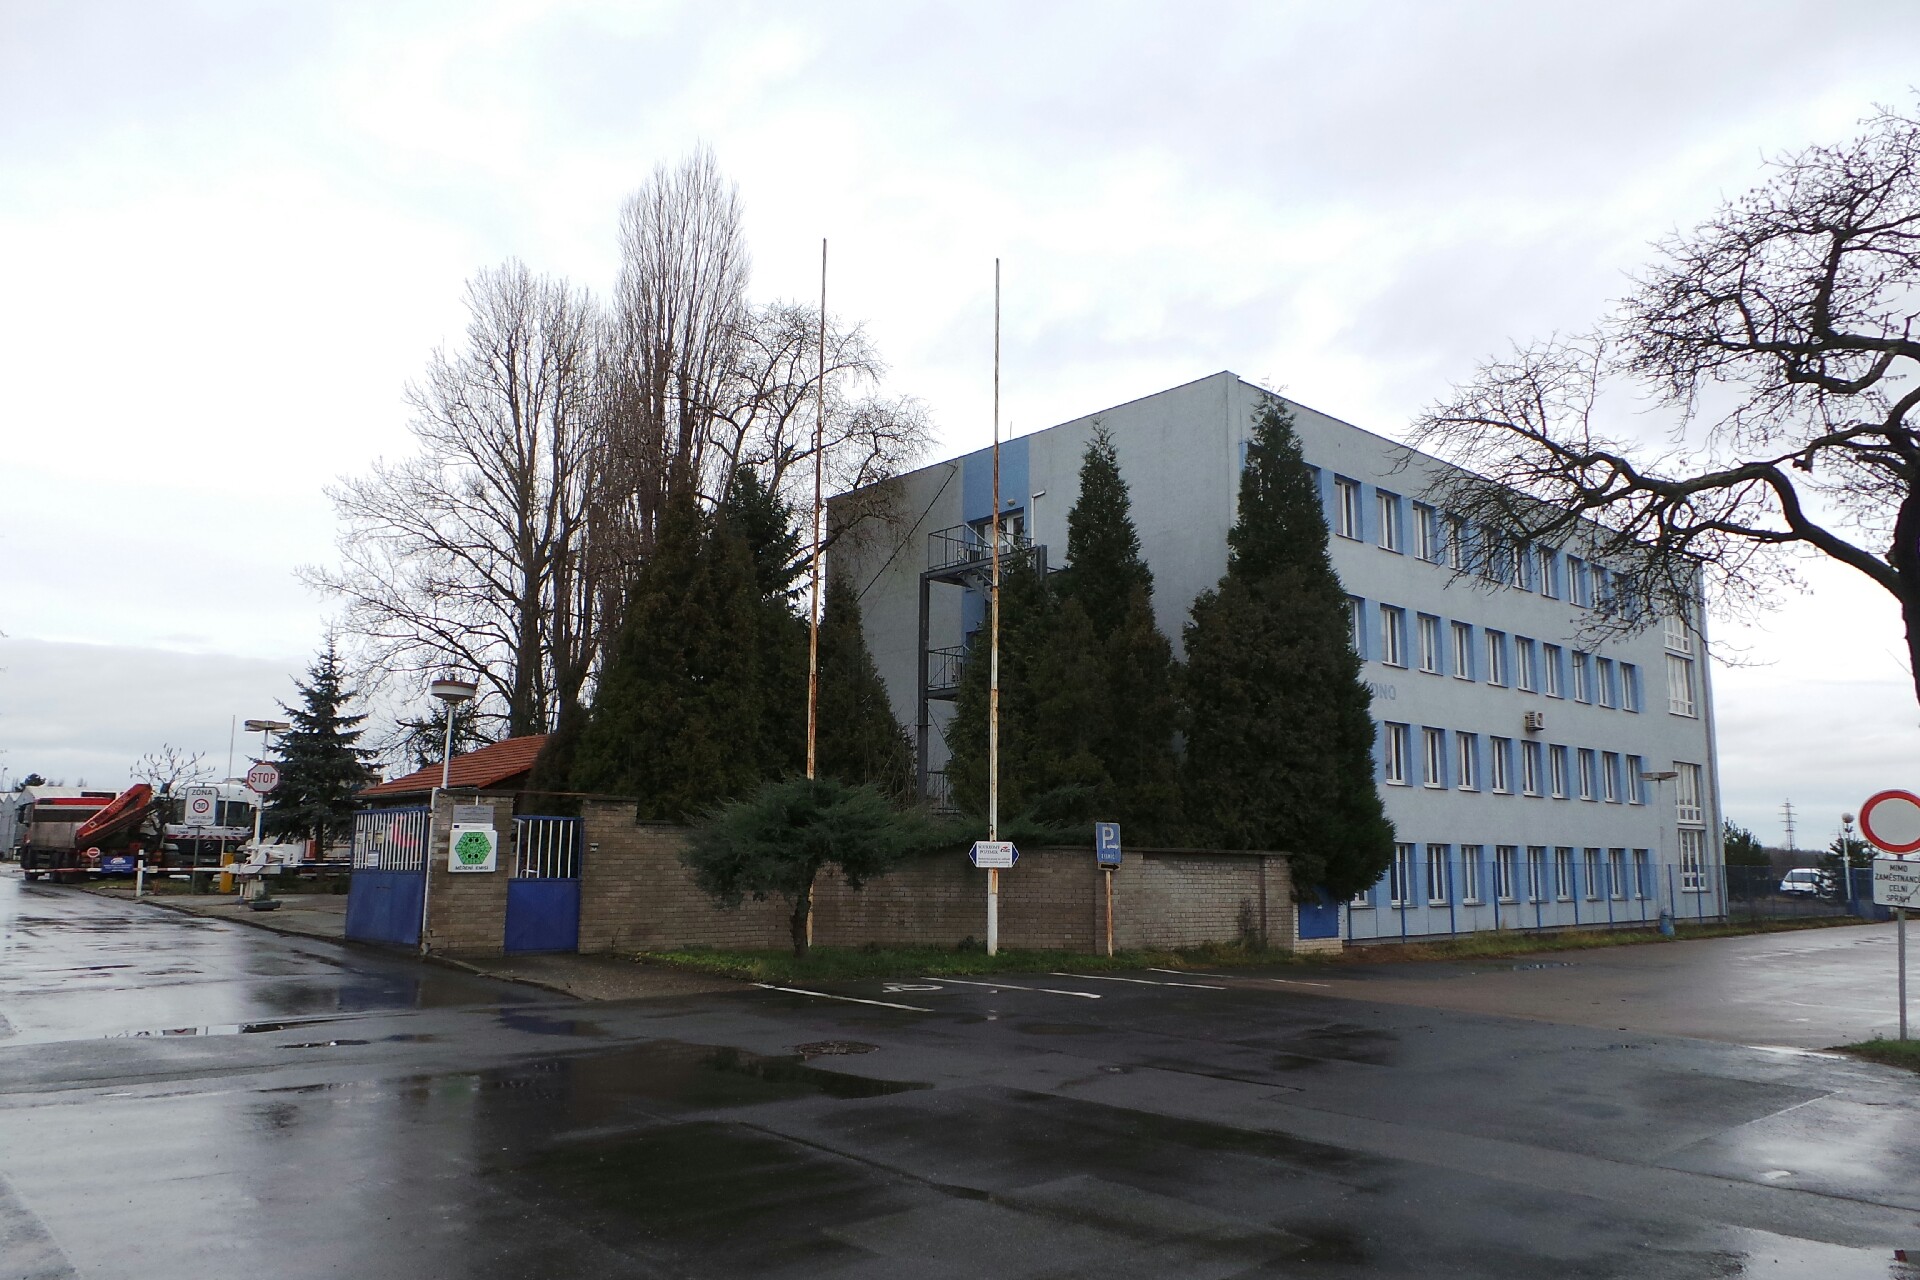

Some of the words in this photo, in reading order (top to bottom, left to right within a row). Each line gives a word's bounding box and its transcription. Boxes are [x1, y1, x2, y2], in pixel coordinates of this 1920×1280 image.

[251, 772, 276, 783] STOP
[191, 788, 213, 796] ZÓNA
[1102, 826, 1115, 849] P
[1890, 864, 1908, 872] MIMO
